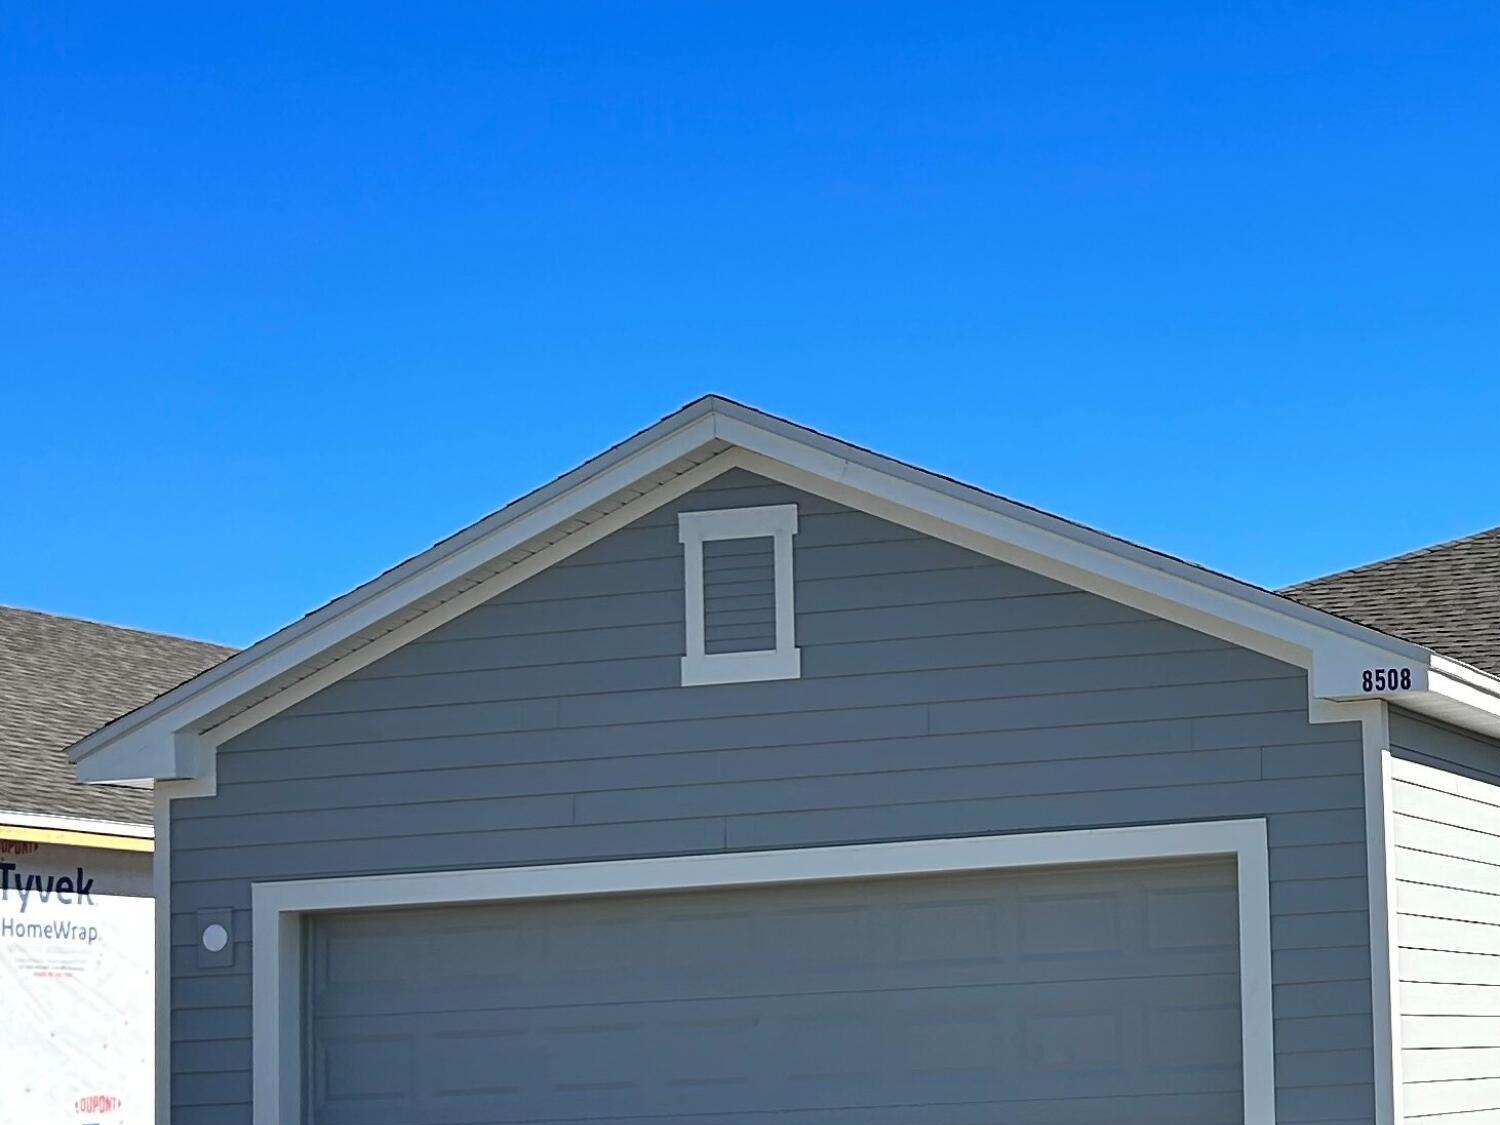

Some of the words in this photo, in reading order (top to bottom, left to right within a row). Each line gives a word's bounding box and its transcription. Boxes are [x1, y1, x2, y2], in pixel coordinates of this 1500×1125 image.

[1362, 668, 1411, 692] 8508
[0, 862, 95, 913] Tyvek
[2, 918, 98, 945] HomeWrap
